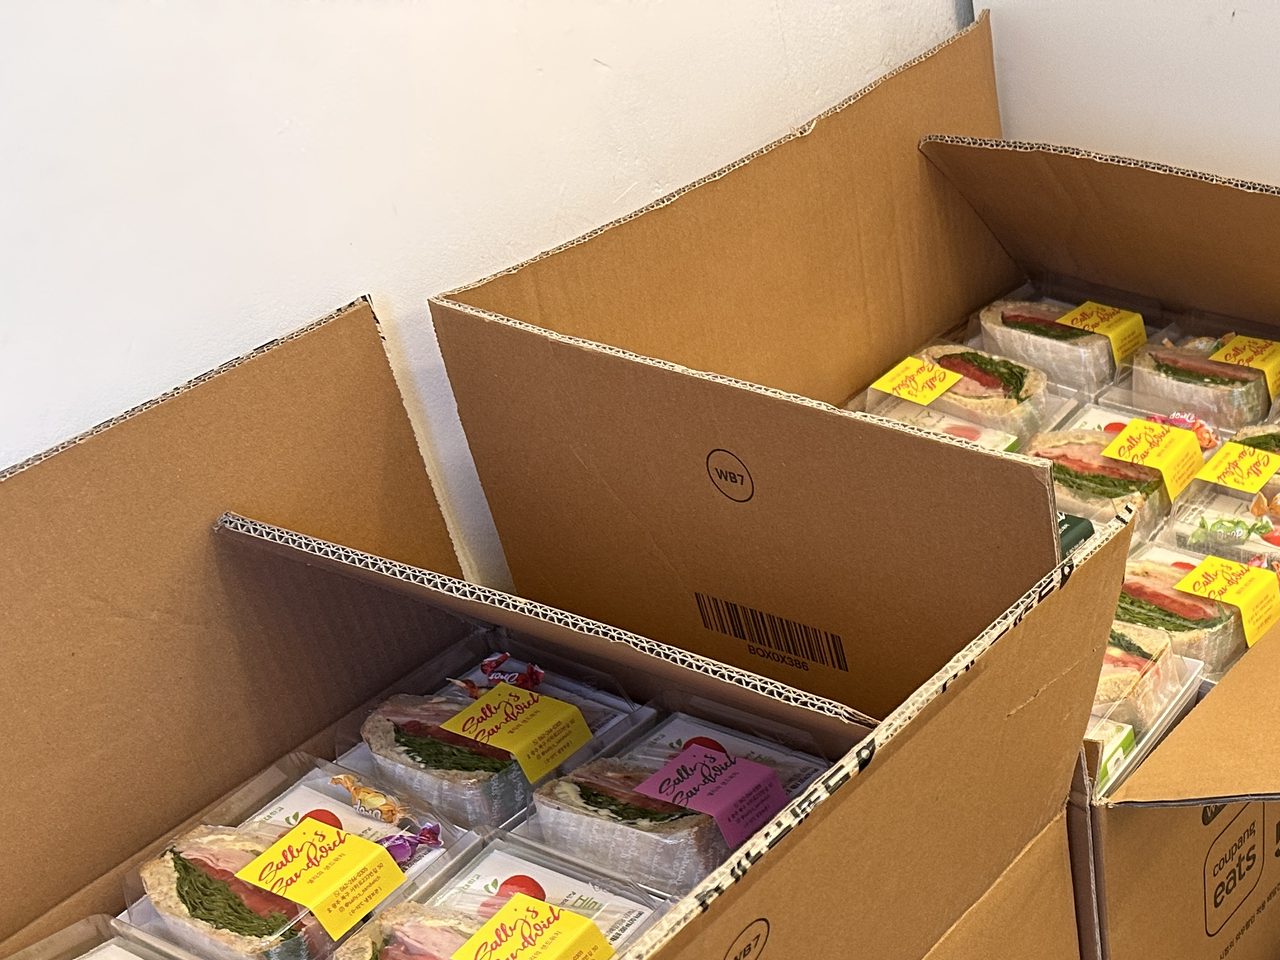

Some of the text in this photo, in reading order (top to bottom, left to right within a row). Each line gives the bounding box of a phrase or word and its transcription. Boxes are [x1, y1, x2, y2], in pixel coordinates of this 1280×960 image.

[715, 467, 745, 485] WB7
[462, 692, 520, 736] Sally's
[659, 753, 716, 796] Sally's
[258, 829, 326, 884] Sally's
[1213, 820, 1256, 877] coupang
[1213, 845, 1256, 909] eats
